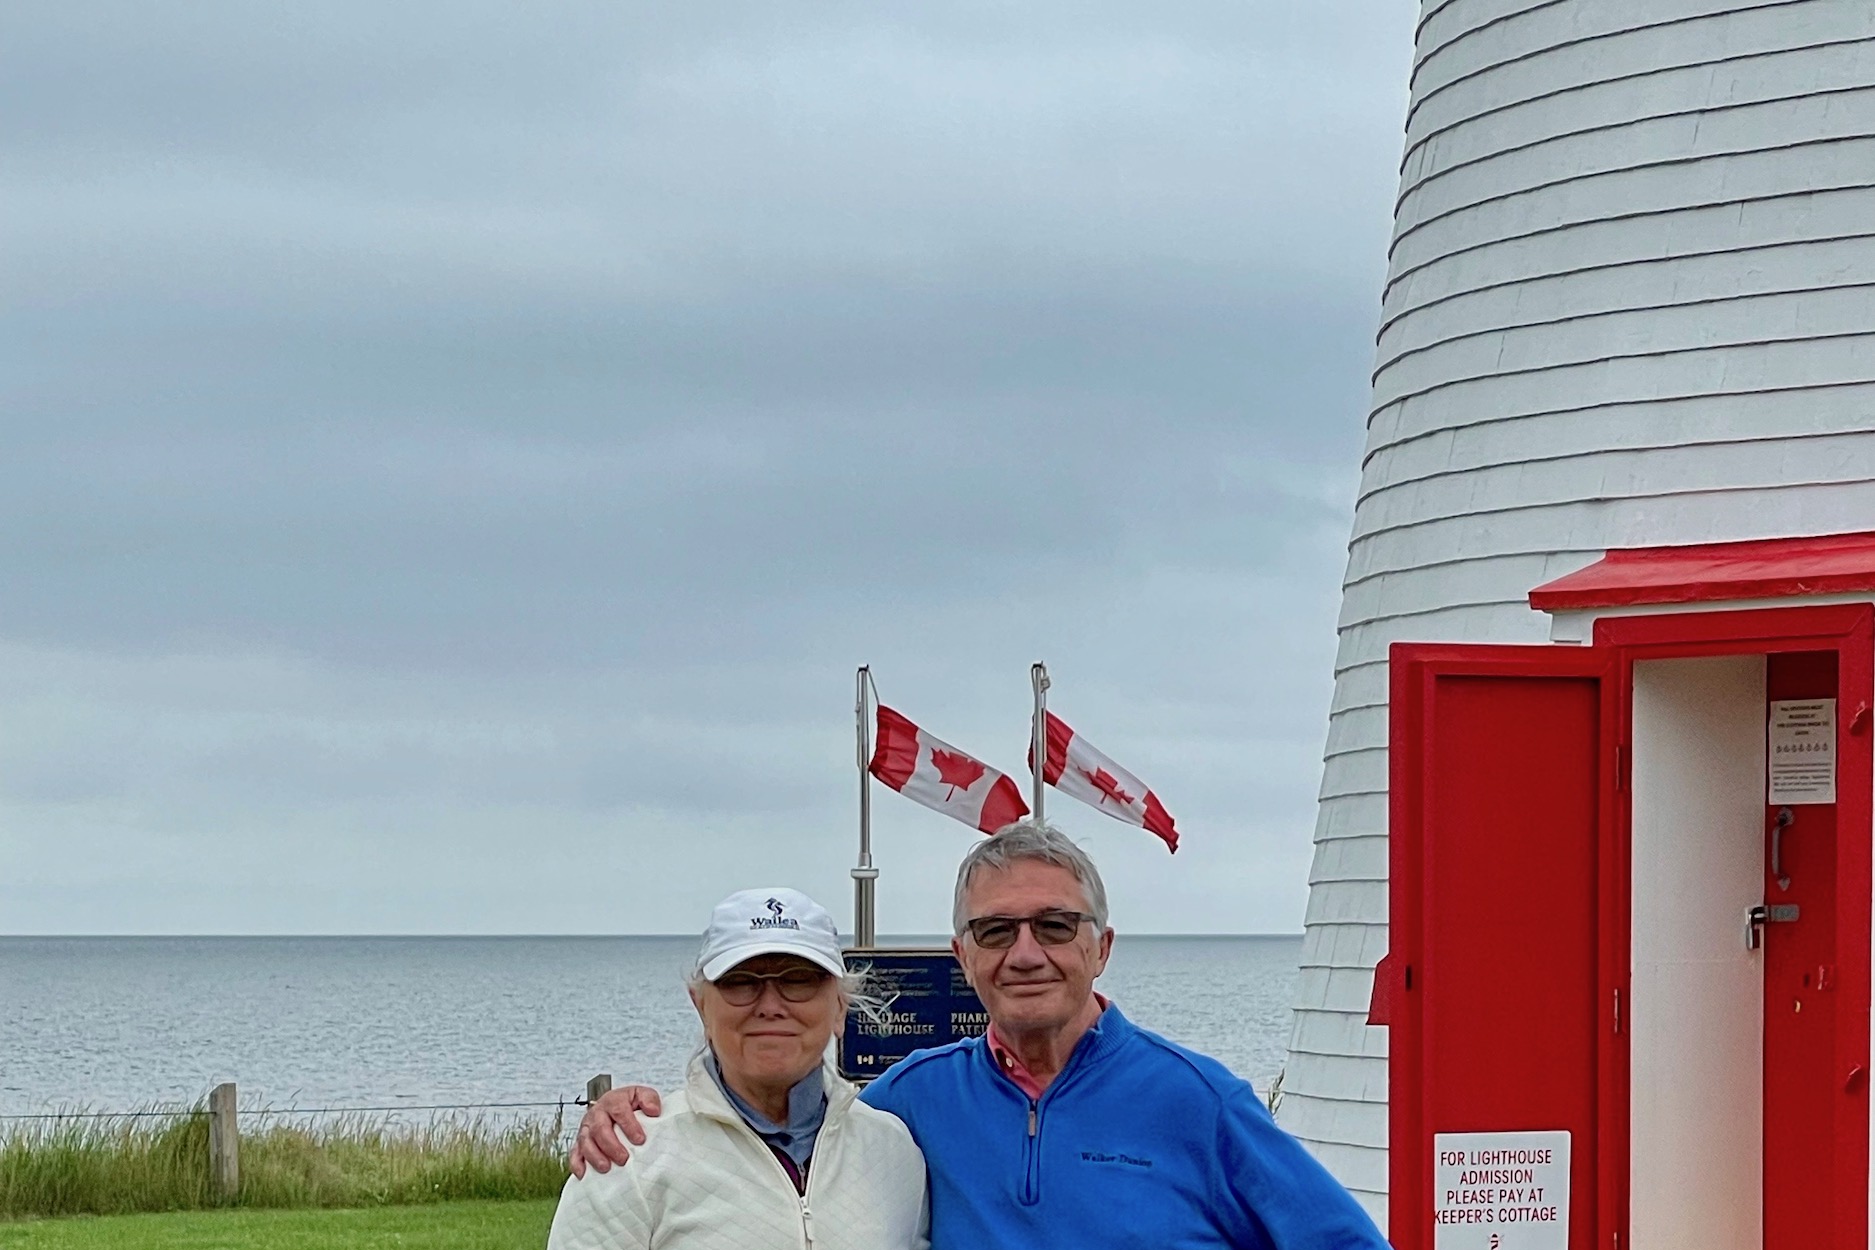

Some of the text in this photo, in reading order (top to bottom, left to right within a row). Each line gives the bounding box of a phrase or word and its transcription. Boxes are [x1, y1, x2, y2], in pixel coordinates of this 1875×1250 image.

[1440, 1149, 1552, 1167] FOR LIGHTHOUSE
[1459, 1169, 1533, 1185] ADMISSION
[1446, 1187, 1545, 1205] PLEASE PAY AT
[1435, 1206, 1557, 1225] KEEPER'S COTTAGE
